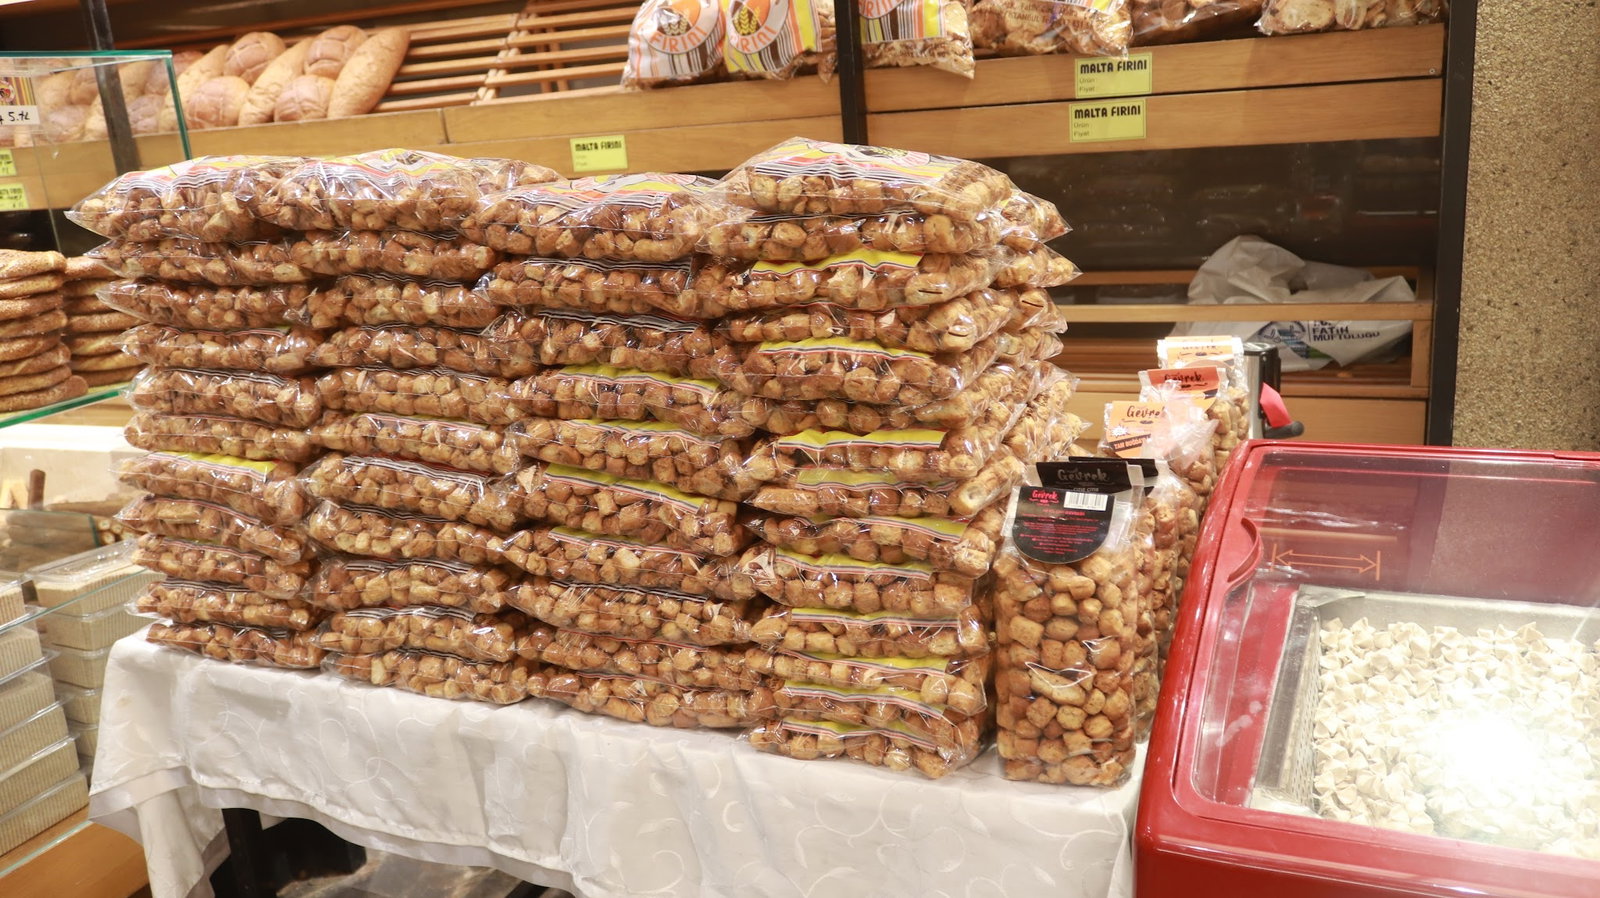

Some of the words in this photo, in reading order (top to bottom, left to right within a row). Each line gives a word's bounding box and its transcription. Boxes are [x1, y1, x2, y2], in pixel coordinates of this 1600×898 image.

[731, 25, 778, 53] IRINI
[1080, 62, 1114, 74] MALTA
[1117, 59, 1147, 72] FIRINI
[1074, 107, 1108, 119] MALTA
[1111, 105, 1141, 117] FIRINI
[575, 142, 599, 151] MALTA
[1057, 467, 1109, 482] Gevrek
